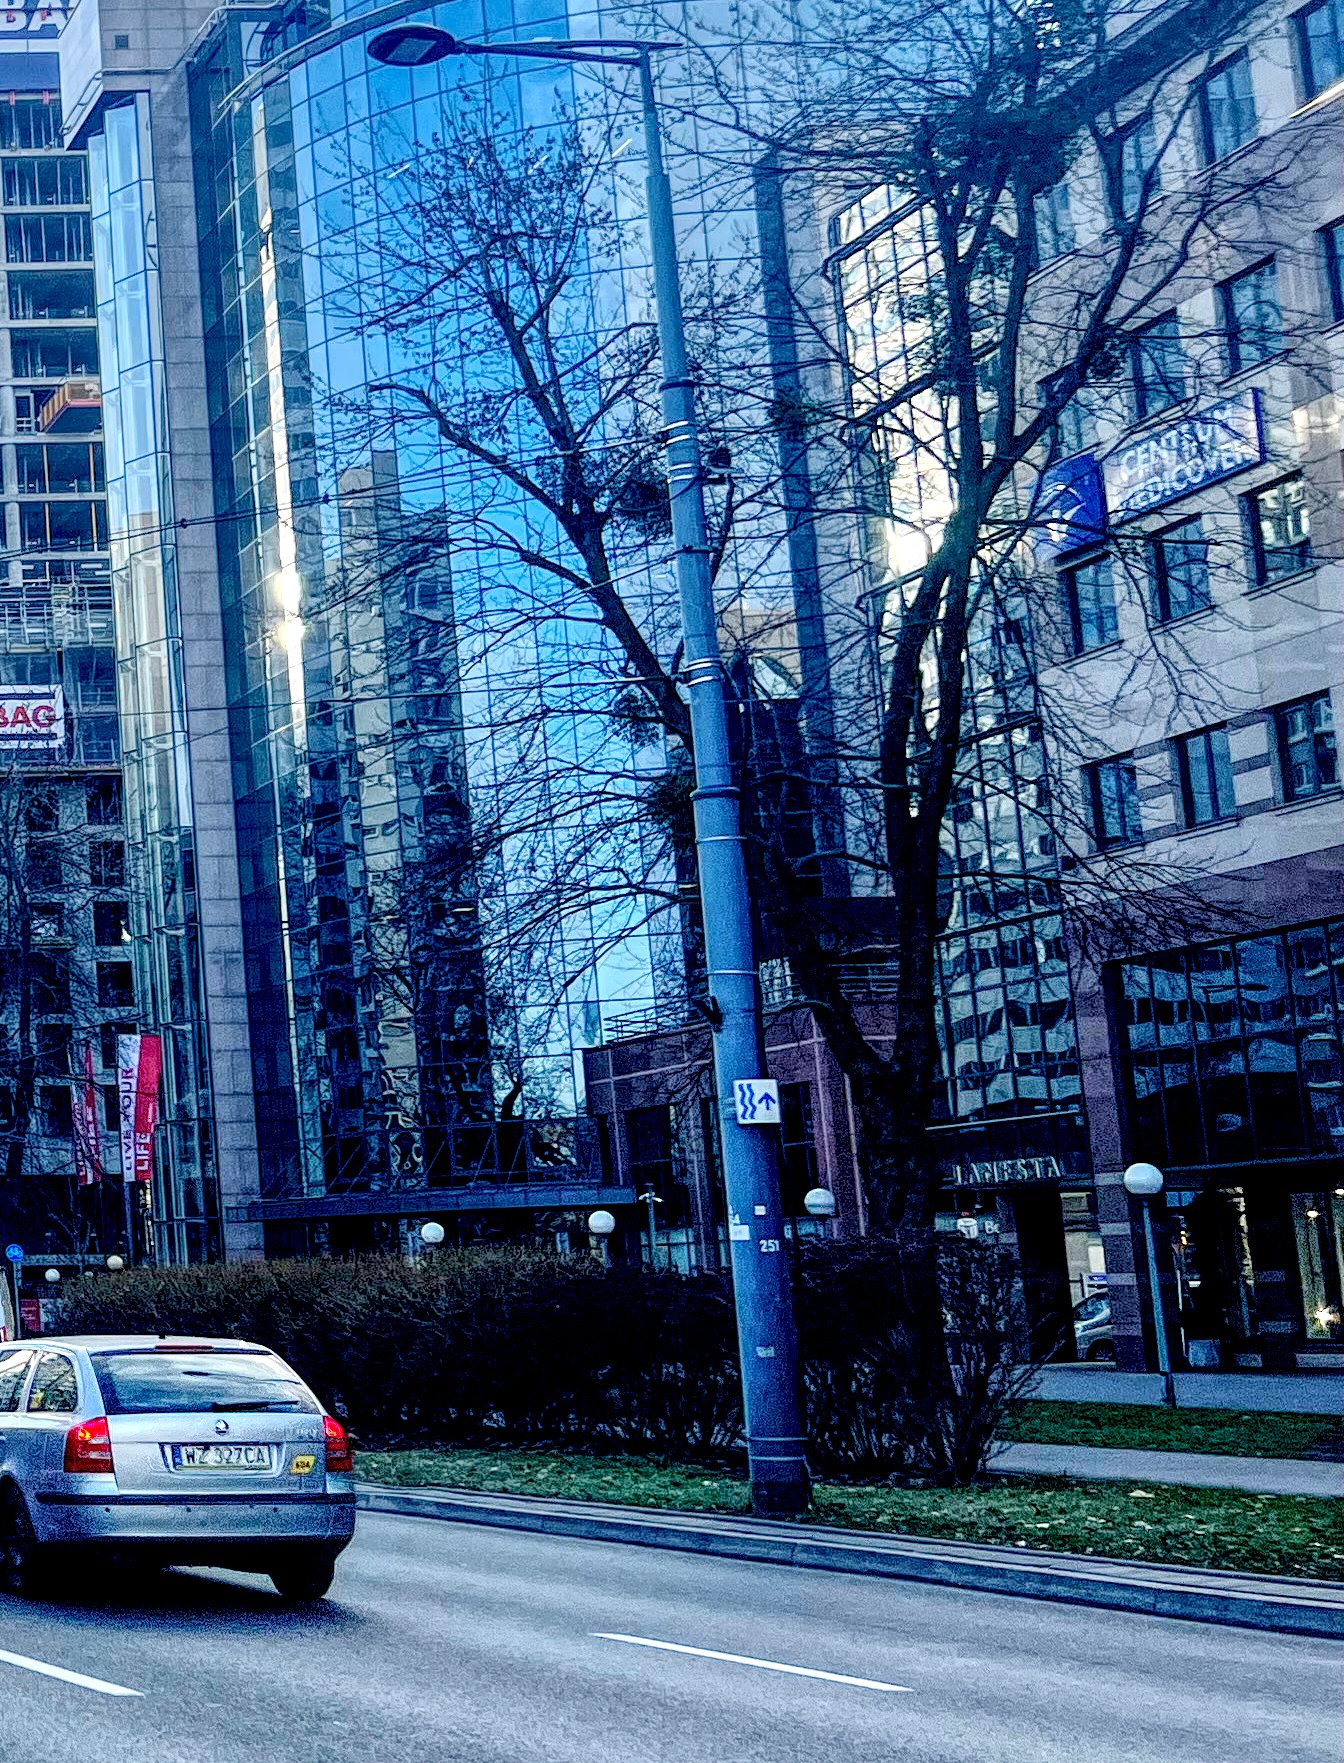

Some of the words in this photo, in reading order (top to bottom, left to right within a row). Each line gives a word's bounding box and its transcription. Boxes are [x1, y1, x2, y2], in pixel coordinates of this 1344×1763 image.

[1120, 403, 1233, 477] CENTRUM
[136, 1132, 151, 1171] LIFE
[759, 1239, 780, 1252] 251
[184, 1445, 210, 1465] WZ
[213, 1444, 266, 1465] 327CA
